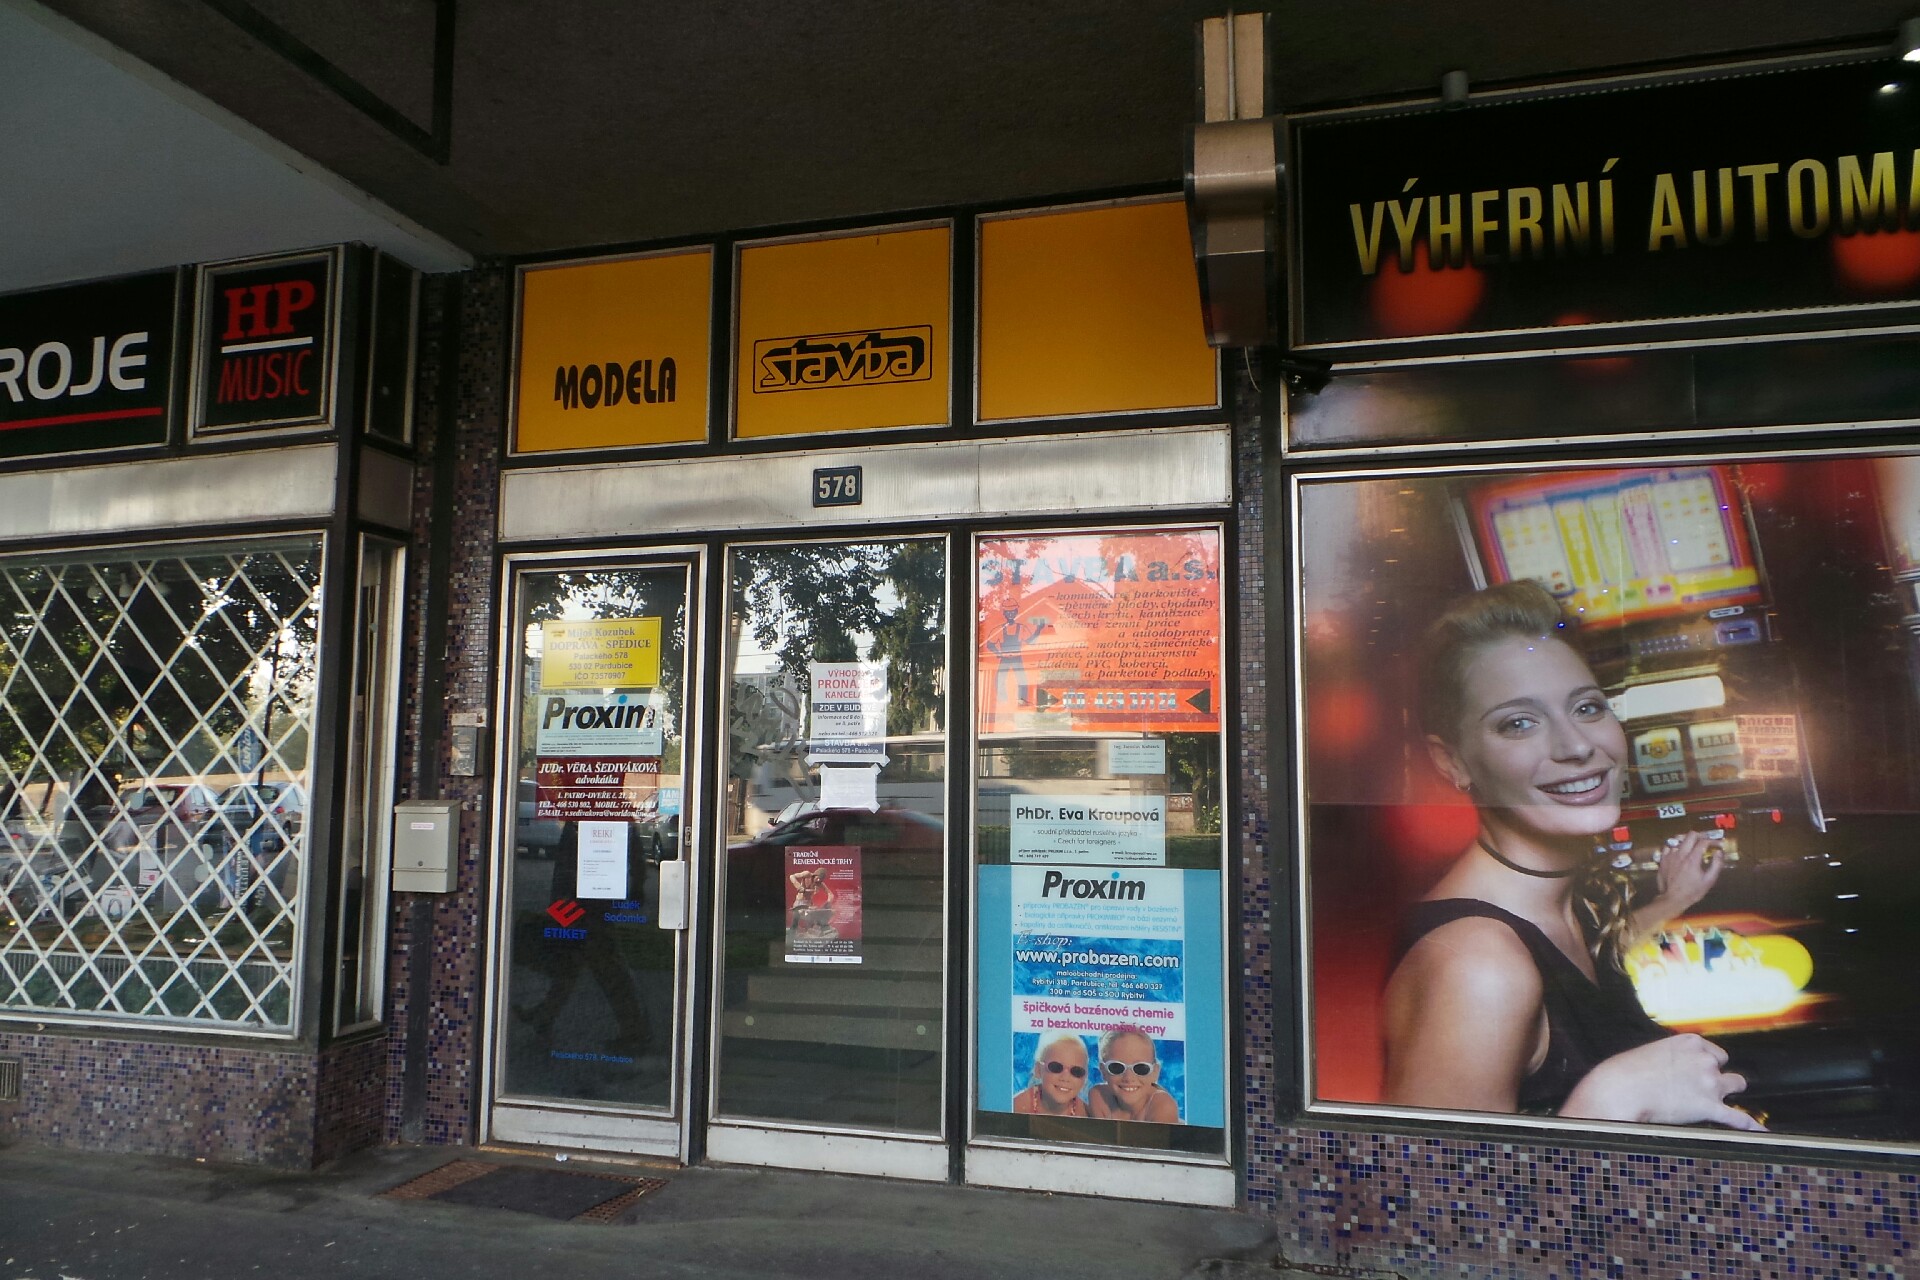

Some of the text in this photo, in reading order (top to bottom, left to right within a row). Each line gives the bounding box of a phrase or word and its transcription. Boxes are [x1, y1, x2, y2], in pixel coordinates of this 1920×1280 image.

[1349, 149, 1920, 276] VÝHERNÍ AUTOM
[222, 279, 315, 341] HP
[217, 349, 313, 405] MUSIC
[554, 356, 677, 410] MODELA
[817, 473, 858, 500] 578
[595, 626, 635, 637] Kozubek
[1133, 628, 1211, 640] autodoprava
[550, 638, 651, 651] DOPRAVA SPEDICE
[574, 651, 613, 660] Palackého
[594, 662, 633, 670] Pardubice
[1098, 667, 1158, 679] parketové
[819, 704, 835, 712] ZDE
[837, 704, 843, 712] V
[824, 739, 856, 747] STAVBA
[539, 761, 658, 774] JUDr. VĚRA ŠEDIVÁKOVÁ
[575, 774, 619, 785] advokátka
[1651, 771, 1680, 785] BAR
[1016, 806, 1160, 824] PhDr. Eva Kroupová
[592, 829, 613, 838] REIKI
[1037, 828, 1057, 836] soudní
[1057, 837, 1076, 845] Czech
[1042, 870, 1146, 900] Proxim
[544, 927, 588, 940] ETIKET
[1016, 949, 1179, 968] www.probazen.com
[1056, 969, 1103, 978] maloobchodní
[1083, 988, 1097, 997] SOŠ
[1104, 990, 1119, 998] SOU
[1121, 991, 1145, 1000] Rybitví
[1023, 1001, 1174, 1019] špičková bazénová chemie
[1031, 1018, 1044, 1028] za
[1141, 1025, 1166, 1037] ceny
